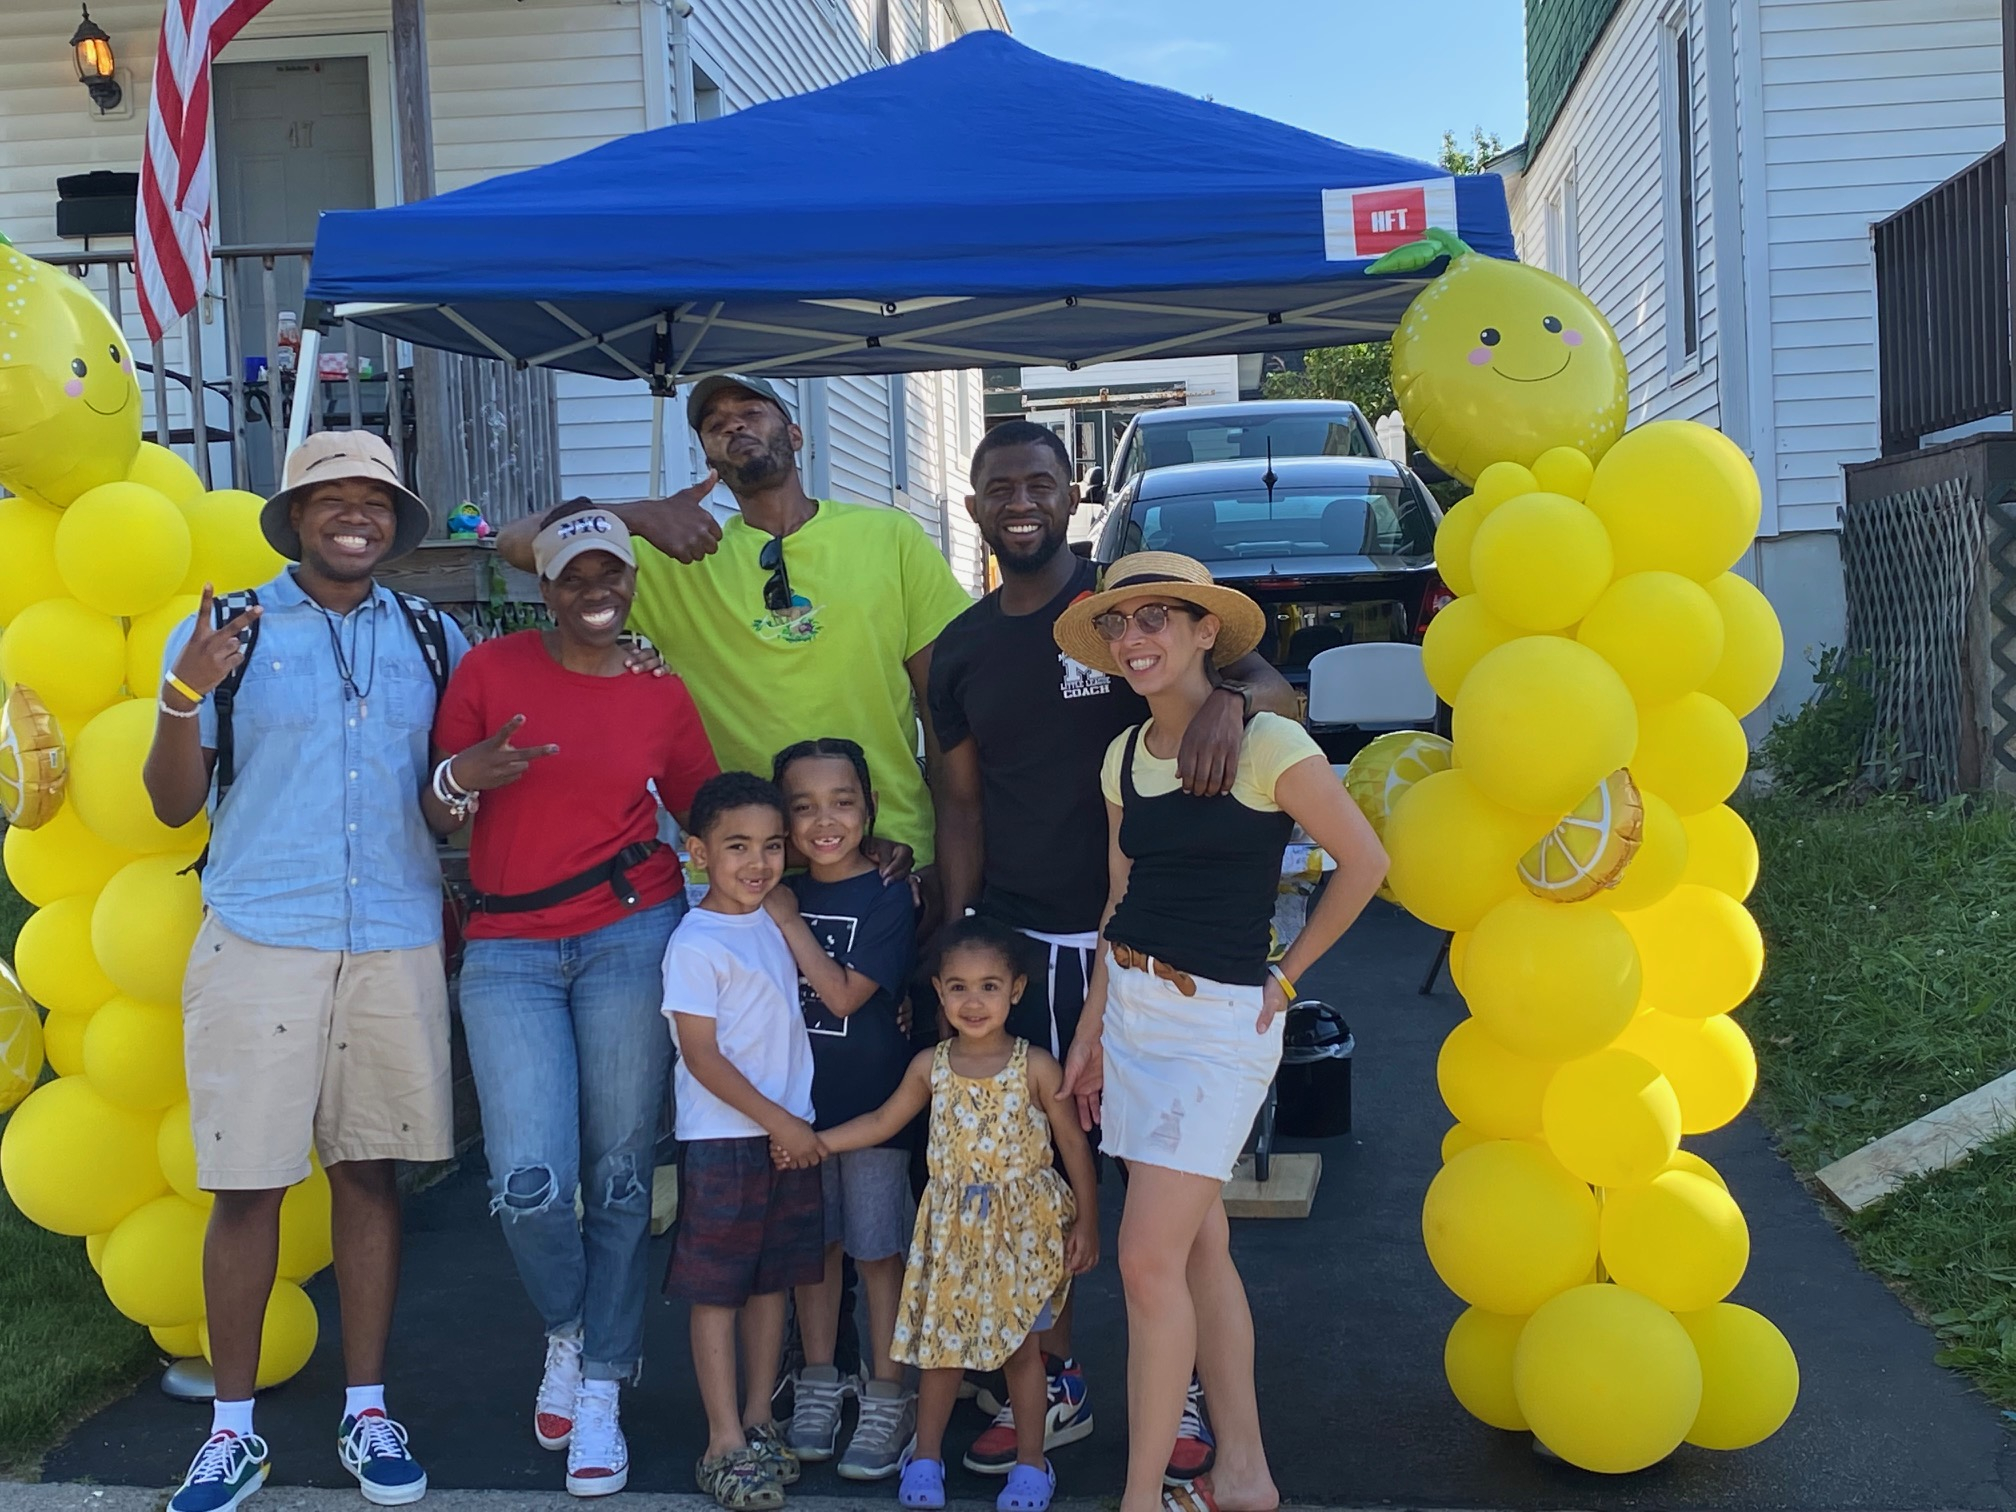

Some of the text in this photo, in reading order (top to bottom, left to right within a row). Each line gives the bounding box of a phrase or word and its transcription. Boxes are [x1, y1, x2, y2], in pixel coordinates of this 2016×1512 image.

[1371, 208, 1408, 233] HFT
[560, 515, 607, 540] NYC
[1063, 684, 1110, 699] COACH
